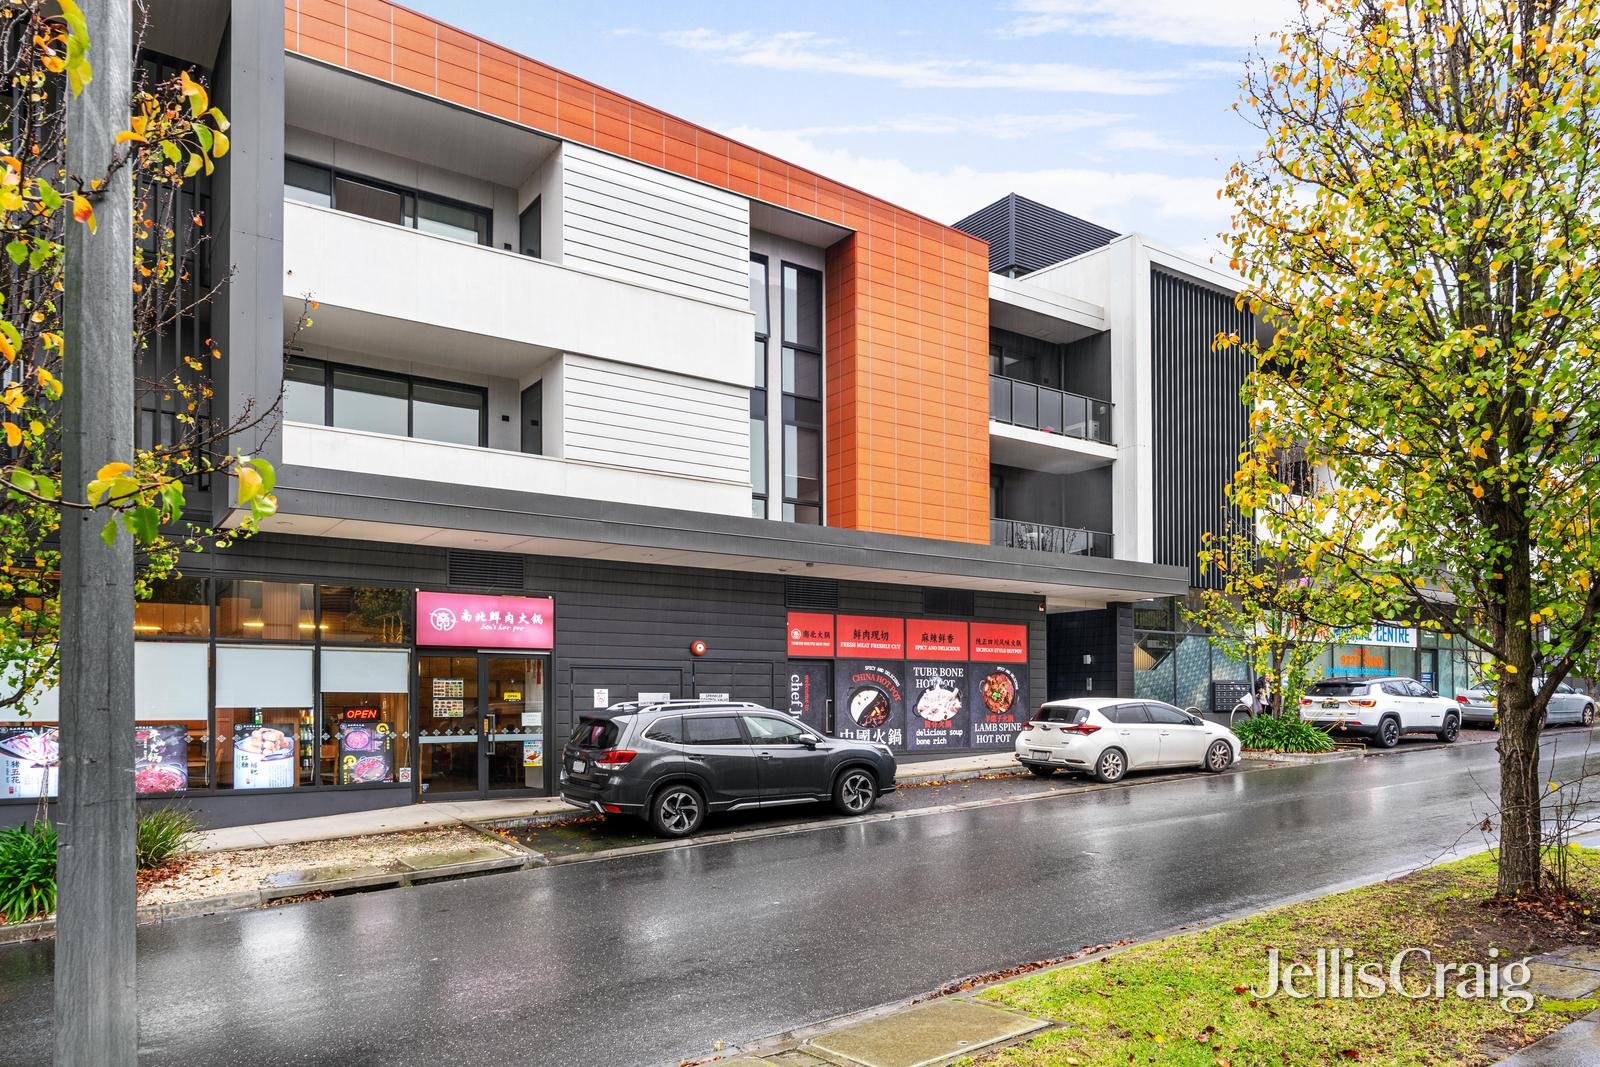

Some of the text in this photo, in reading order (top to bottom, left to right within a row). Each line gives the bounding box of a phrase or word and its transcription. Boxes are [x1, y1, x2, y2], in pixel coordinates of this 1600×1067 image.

[853, 629, 889, 641] 鲜肉现切
[921, 632, 955, 644] 麻辣鲜香
[1376, 625, 1410, 644] CENTRE
[913, 667, 964, 677] TUBE BONE
[852, 672, 902, 702] CHINA HOT POT
[915, 679, 934, 689] HOT
[790, 674, 803, 707] chef
[347, 709, 377, 719] OPEN
[916, 728, 963, 737] delicious soup
[974, 722, 1022, 732] LAMB SPINE
[840, 728, 902, 746] 中國火鍋
[916, 737, 930, 745] bone
[976, 734, 1012, 744] HOT POT
[11, 760, 21, 784] 猪五花
